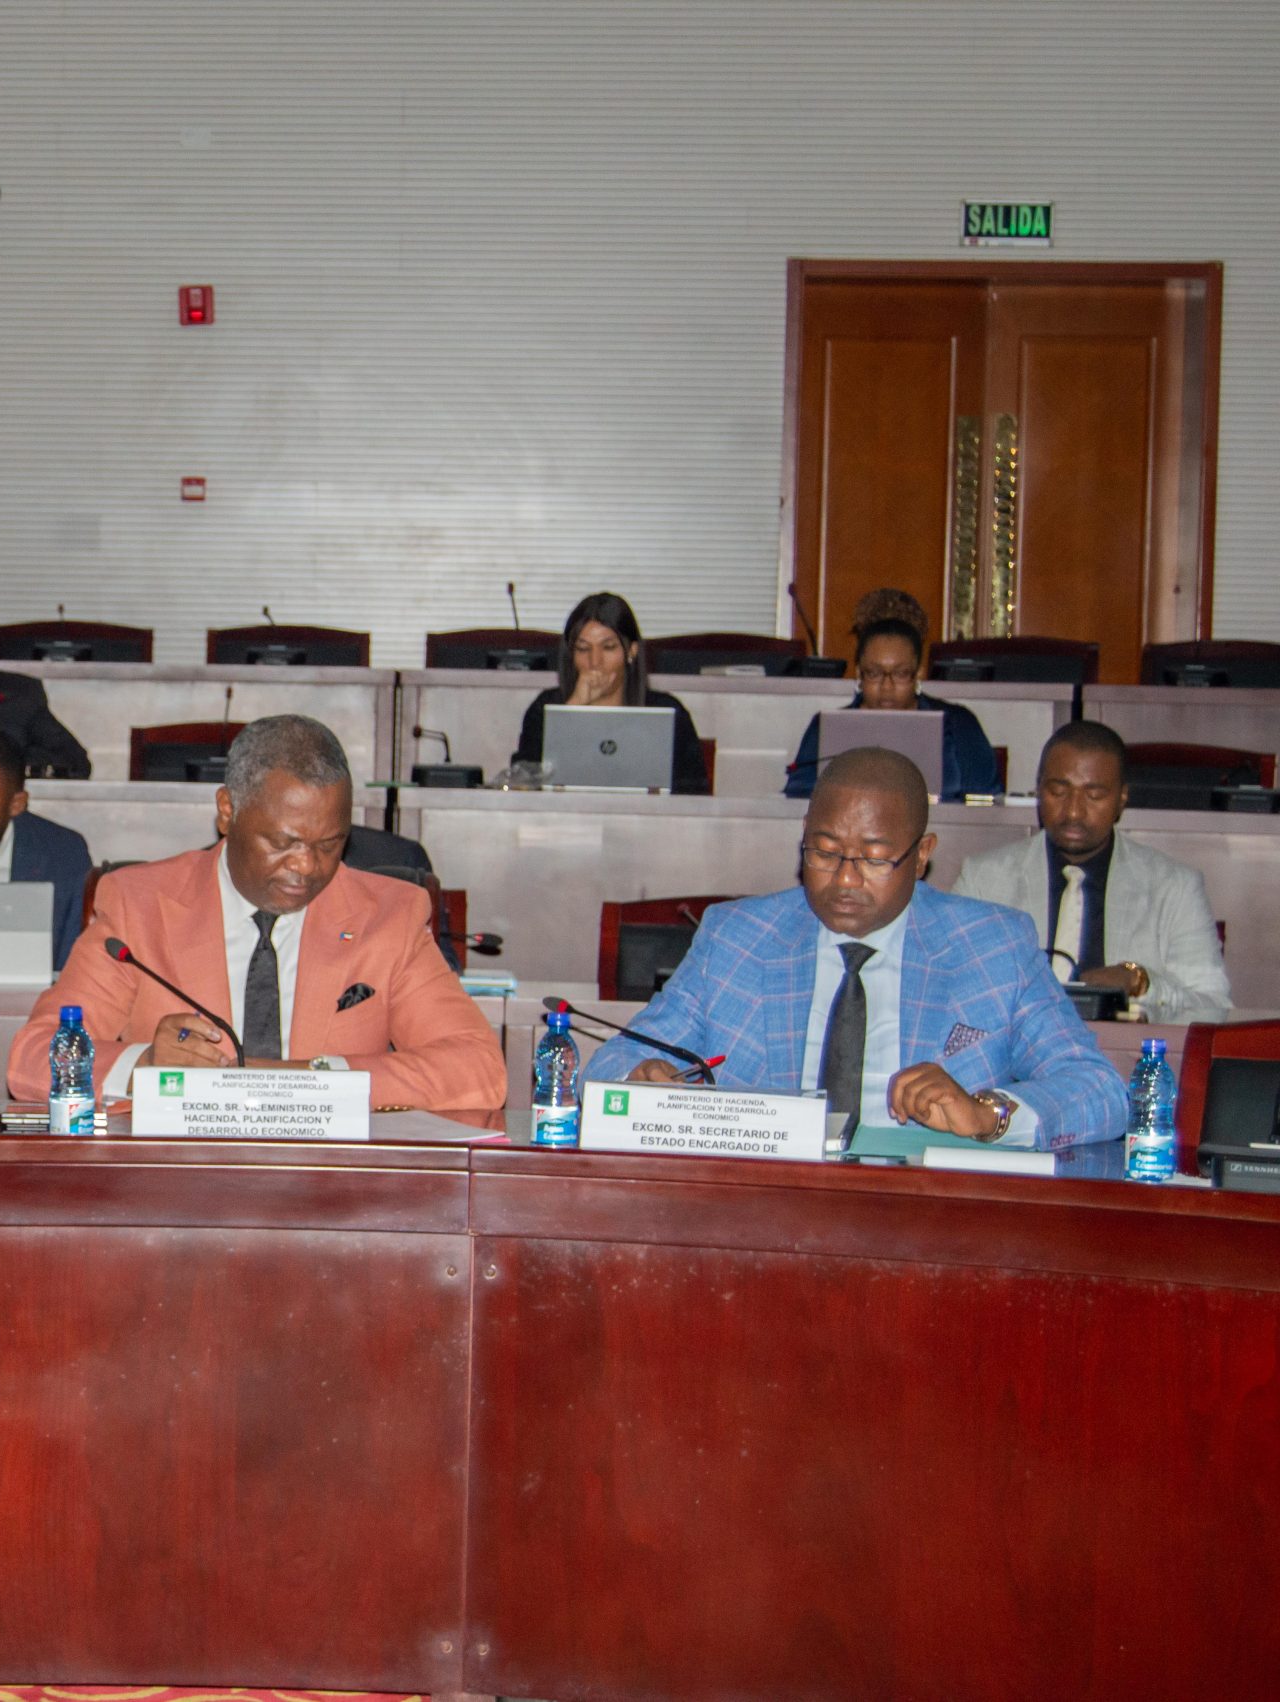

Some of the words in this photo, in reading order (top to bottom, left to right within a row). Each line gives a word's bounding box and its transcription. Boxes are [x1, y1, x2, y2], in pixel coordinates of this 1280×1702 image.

[968, 204, 1047, 236] SALIDA
[212, 1081, 269, 1089] PLANIFICACION
[667, 1094, 711, 1103] MINISTERIO
[182, 1102, 221, 1111] EXCMO.
[224, 1103, 241, 1112] SR.
[319, 1104, 334, 1113] DE
[657, 1102, 715, 1112] PLANIFICACION
[724, 1106, 777, 1116] DESARROLLO
[184, 1114, 240, 1124] HACIENDA,
[243, 1115, 322, 1124] PLANIFICACION
[324, 1116, 332, 1125] Y
[692, 1113, 740, 1122] ECONOMICO
[188, 1126, 259, 1136] DESARROLLO
[632, 1122, 674, 1133] EXCMO.
[678, 1125, 695, 1135] SR.
[699, 1126, 771, 1139] SECRETARIO
[773, 1131, 789, 1141] DE
[640, 1136, 686, 1148] ESTADO
[688, 1139, 760, 1153] ENCARGADO
[763, 1144, 779, 1154] DE
